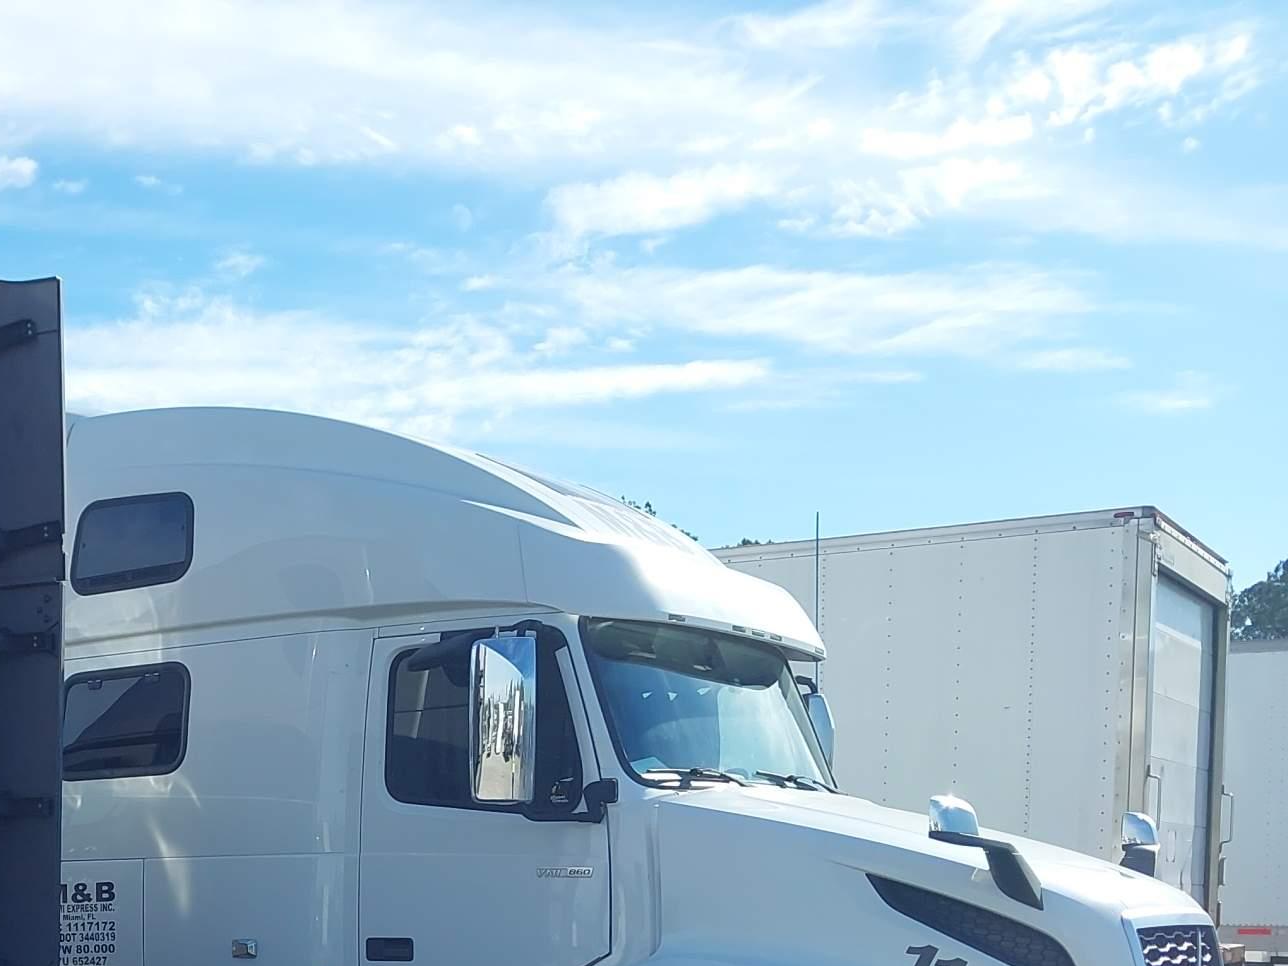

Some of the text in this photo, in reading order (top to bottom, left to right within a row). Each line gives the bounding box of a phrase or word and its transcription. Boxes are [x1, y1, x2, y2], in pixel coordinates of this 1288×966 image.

[67, 903, 98, 913] EXPRESS
[100, 903, 115, 912] INC.
[66, 921, 116, 932] 1117172
[79, 932, 116, 942] 3440319
[76, 943, 115, 954] 80.000
[72, 956, 108, 966] 652427
